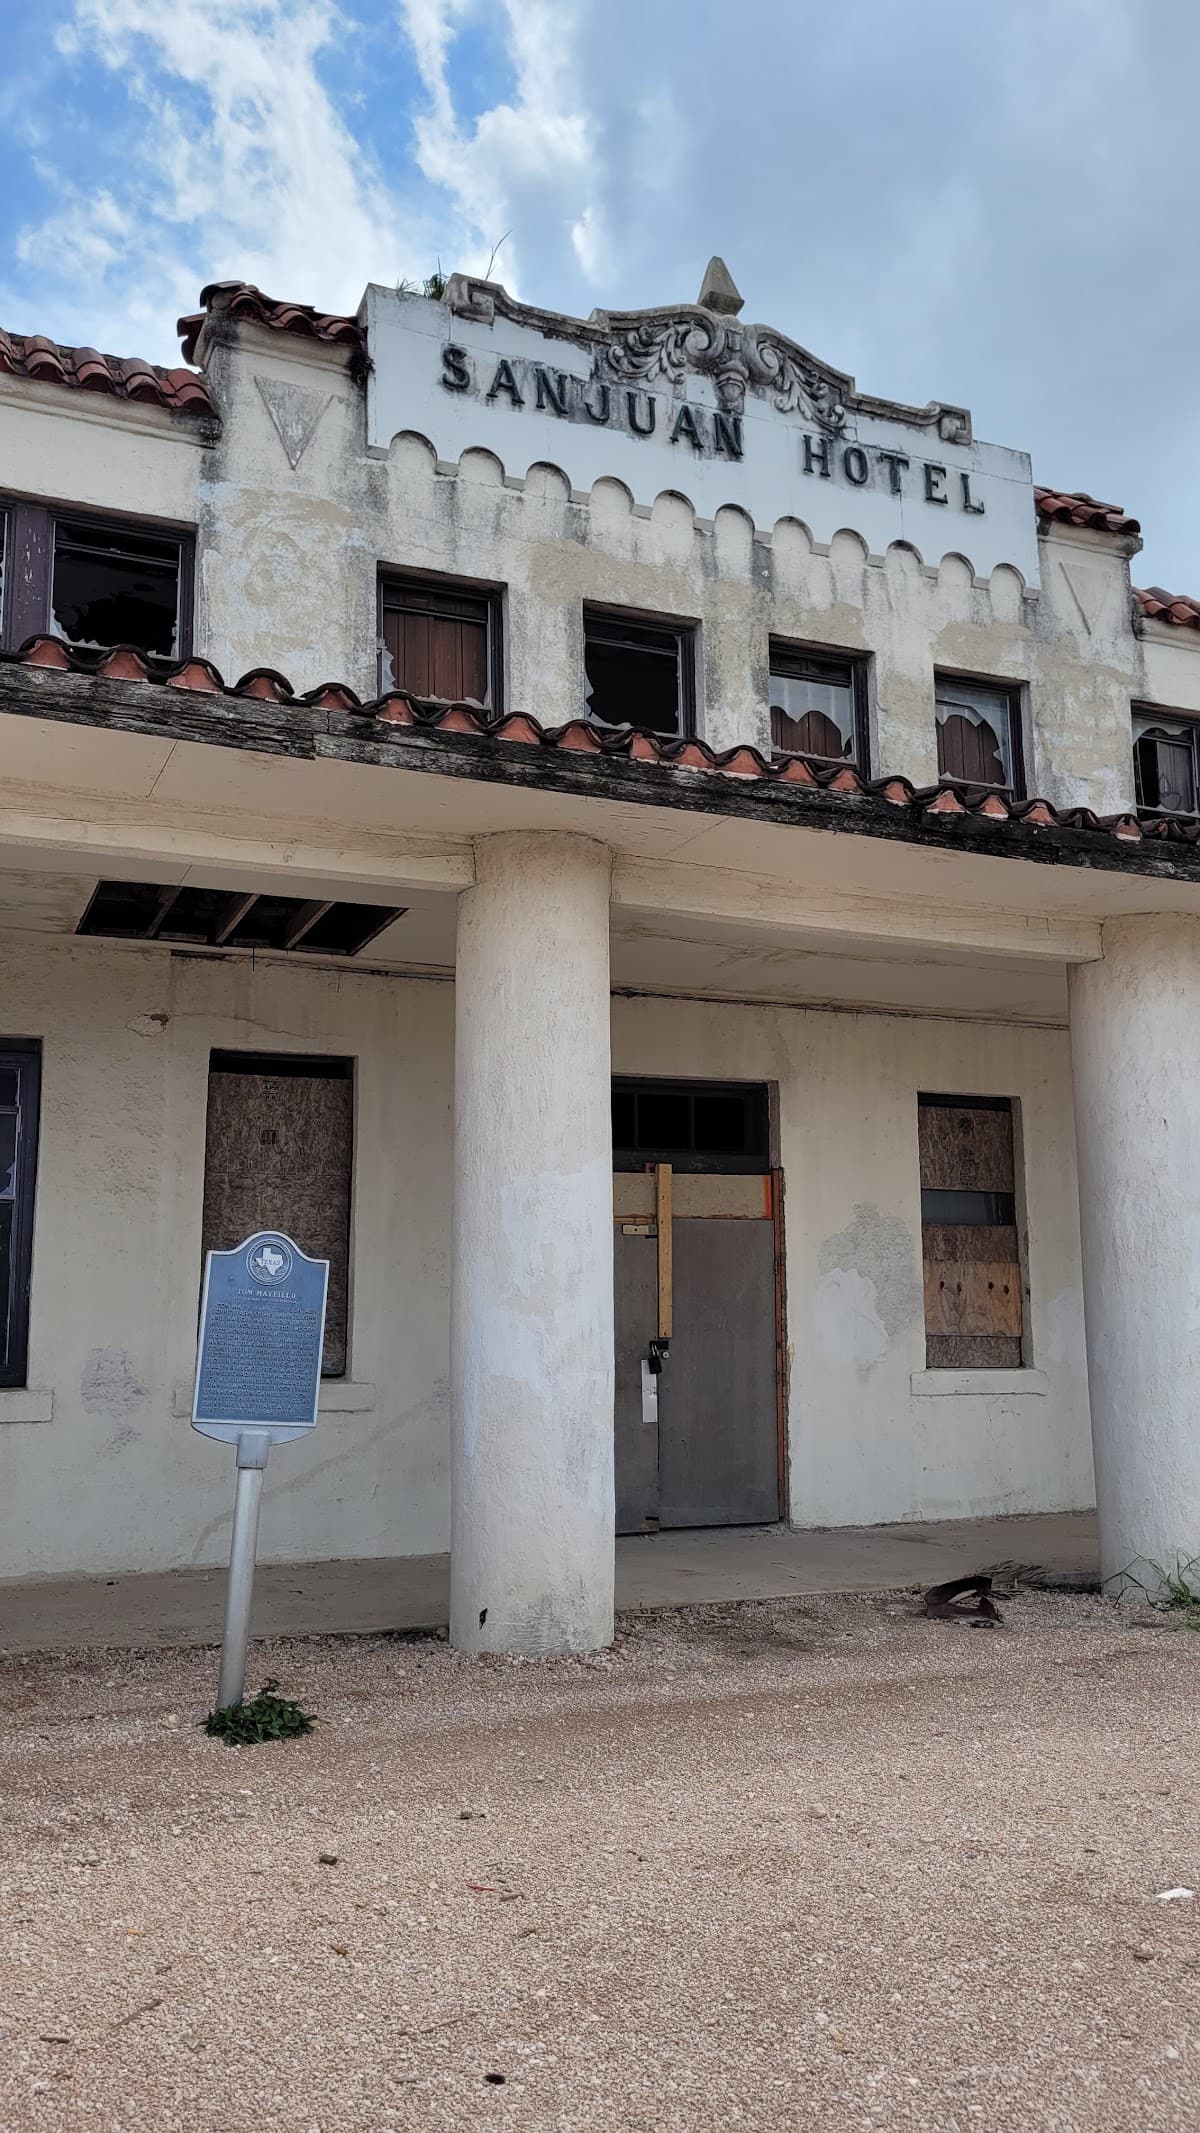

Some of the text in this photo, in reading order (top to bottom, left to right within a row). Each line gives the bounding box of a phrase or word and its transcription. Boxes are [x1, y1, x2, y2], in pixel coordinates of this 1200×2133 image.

[802, 434, 985, 515] HOTEL
[260, 1258, 281, 1267] TEXAS
[236, 1288, 297, 1299] TOM MAYFIELD
